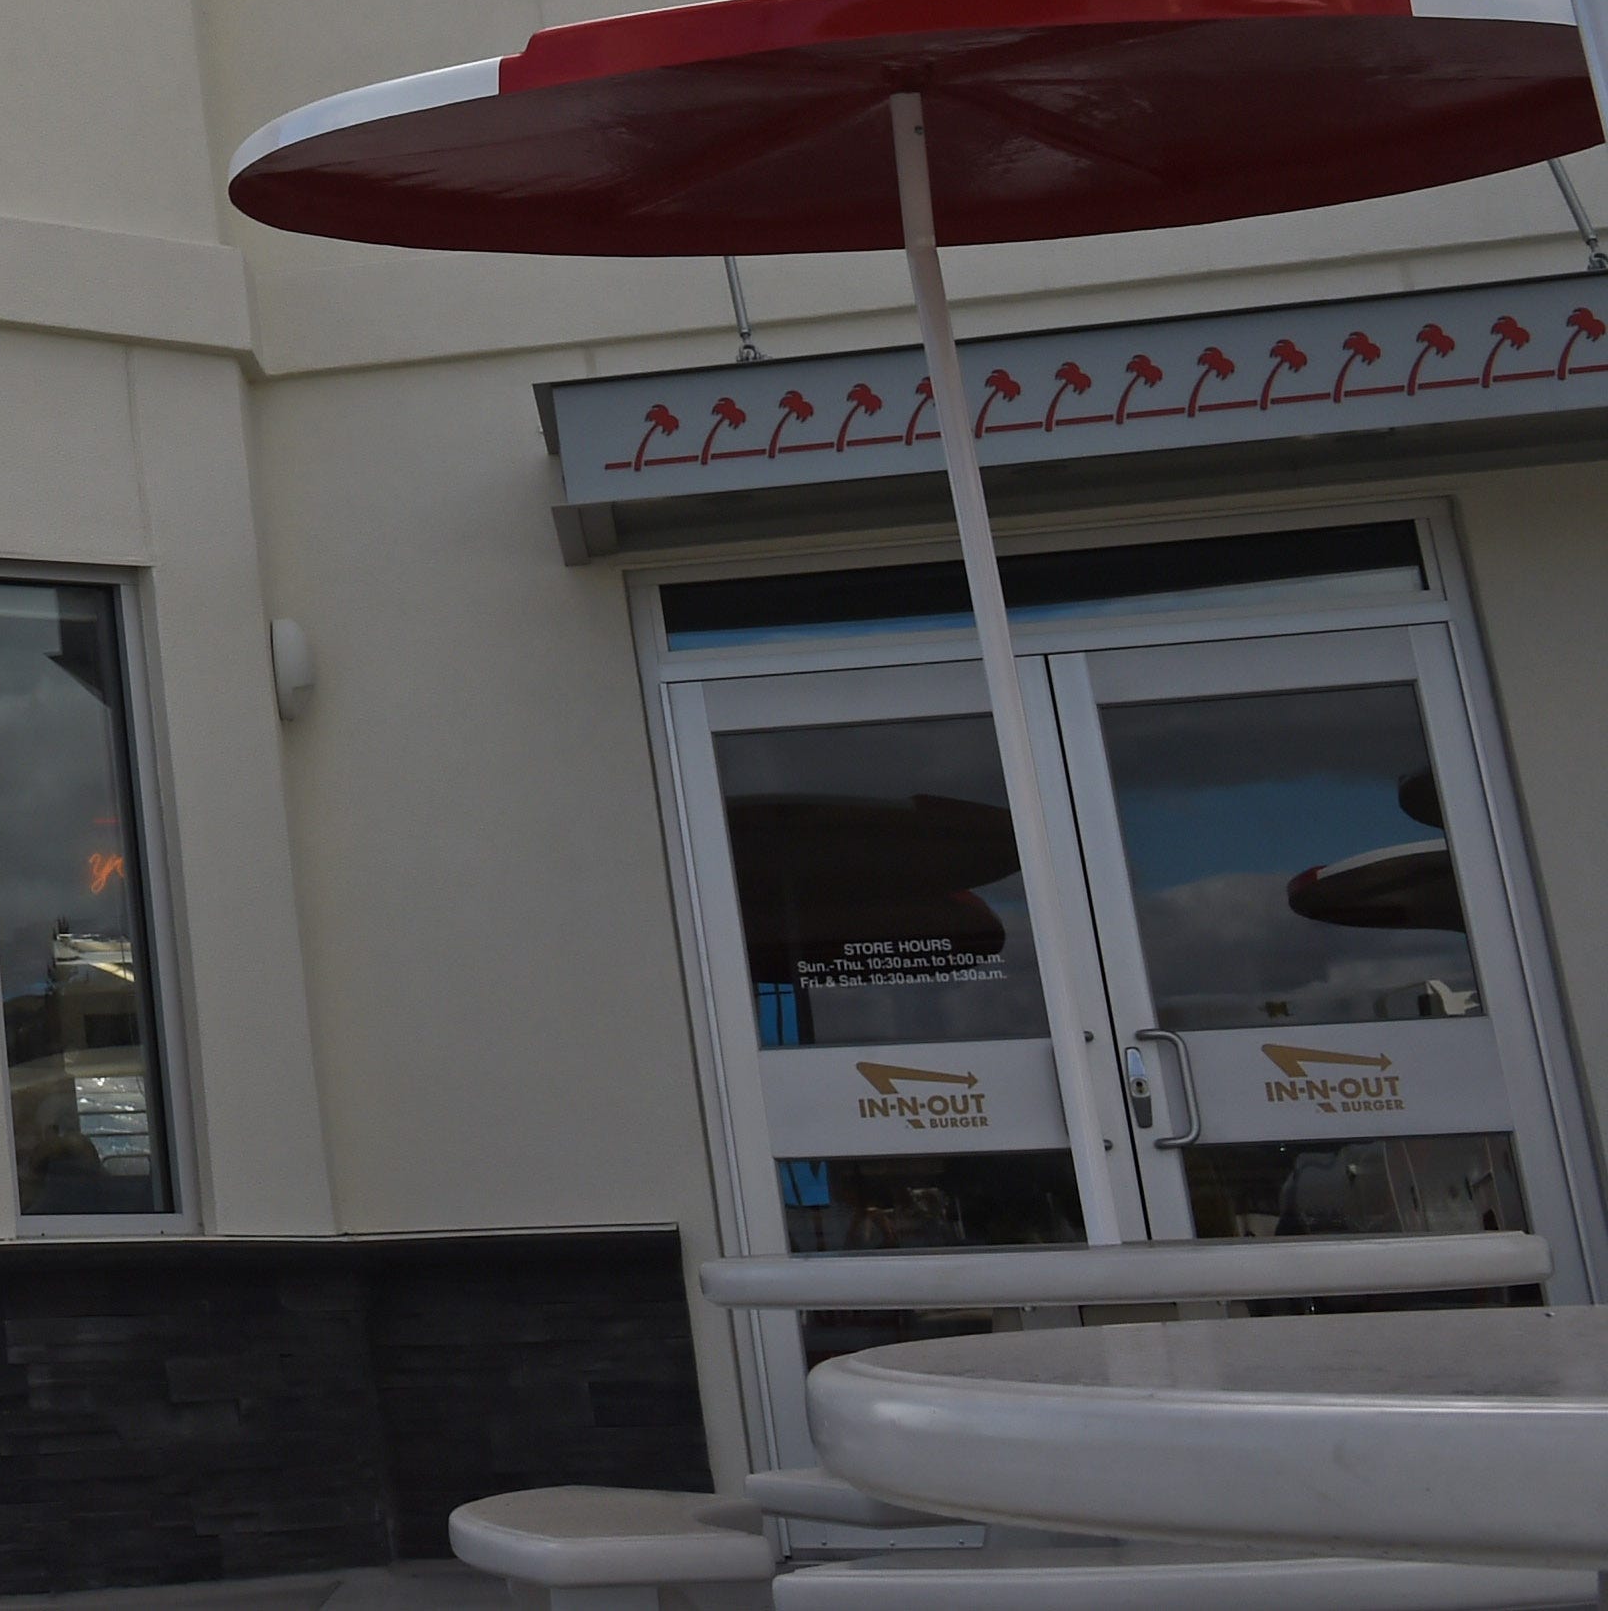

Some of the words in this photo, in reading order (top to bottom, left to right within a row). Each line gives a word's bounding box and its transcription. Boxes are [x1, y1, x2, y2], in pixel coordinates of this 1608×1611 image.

[844, 941, 894, 956] STORE
[898, 938, 952, 953] HOURS
[867, 956, 901, 970] 10:30
[931, 955, 946, 967] to
[800, 976, 823, 988] Fri.
[825, 975, 835, 988] &
[839, 974, 867, 987] Sat.
[870, 972, 904, 985] 10:30
[935, 970, 949, 982] to
[1340, 1099, 1405, 1112] BURGER
[929, 1116, 989, 1129] BURGER
